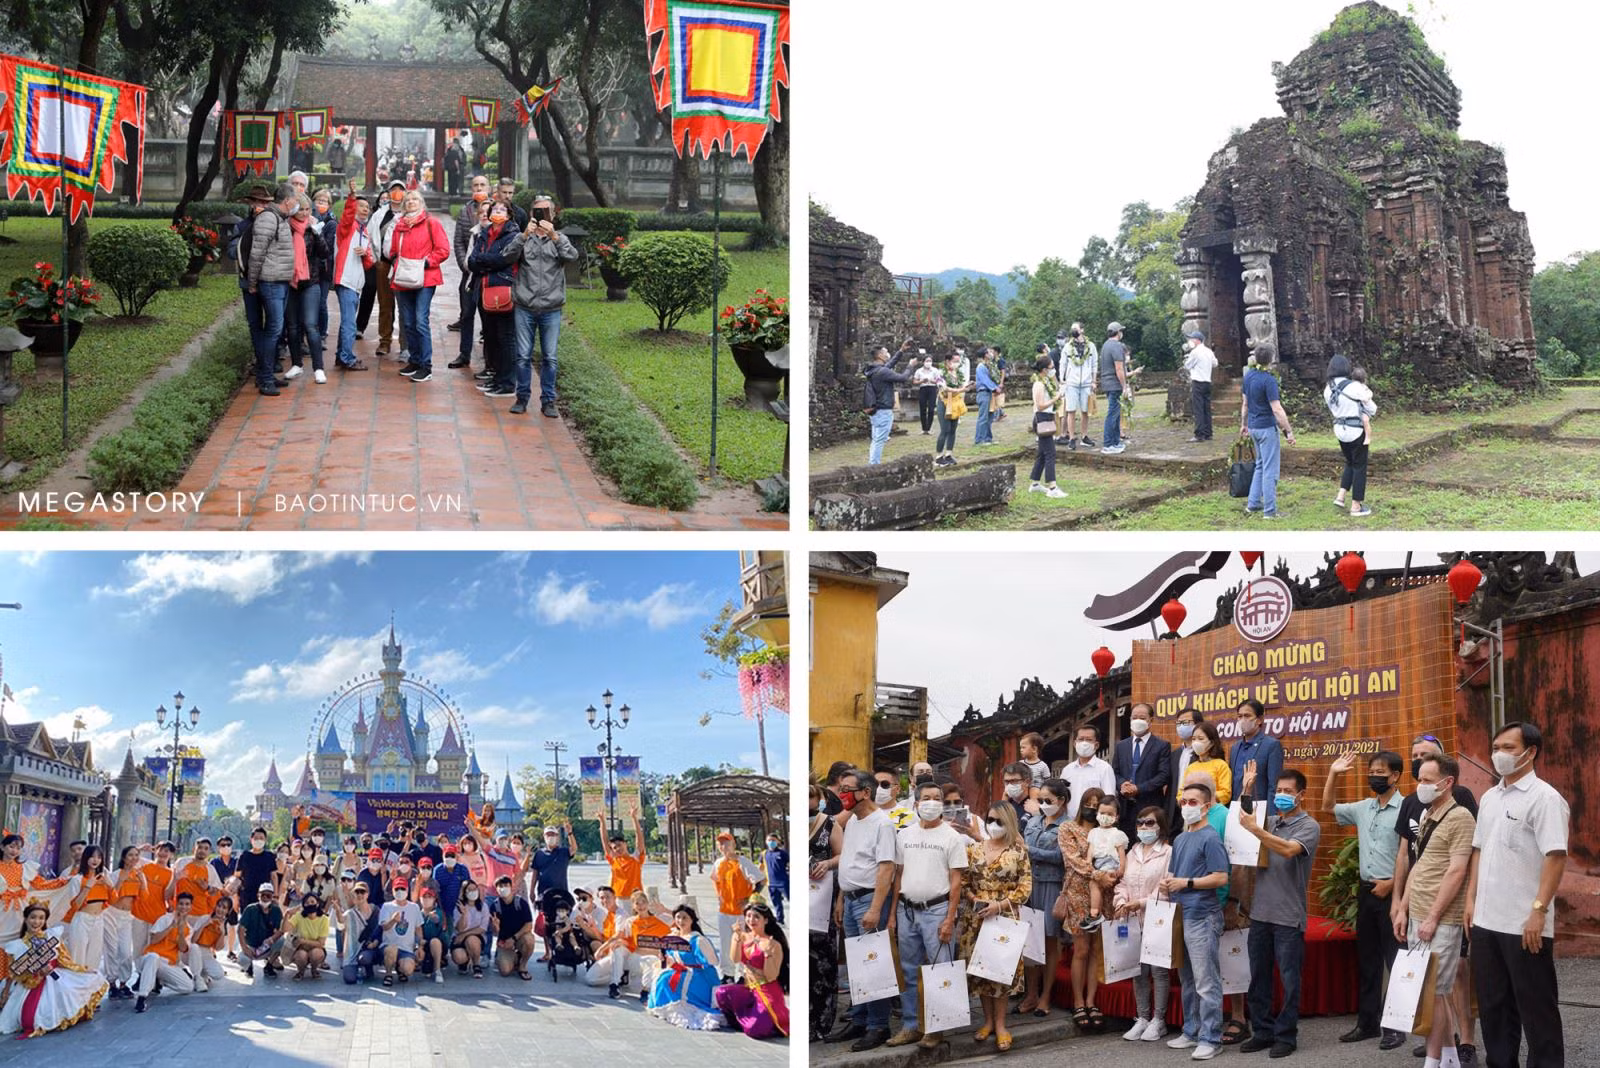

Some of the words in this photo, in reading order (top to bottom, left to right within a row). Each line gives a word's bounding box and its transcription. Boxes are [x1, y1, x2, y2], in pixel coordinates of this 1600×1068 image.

[1213, 649, 1259, 676] CHÀO
[1265, 640, 1326, 670] MỪNG
[1156, 692, 1188, 718] QUÝ
[1193, 688, 1249, 713] KHÁCH
[1255, 680, 1280, 705] VỀ
[1285, 677, 1317, 702] VỚI
[1325, 671, 1359, 701] HỘI
[1367, 669, 1396, 694] AN
[1263, 717, 1285, 735] TO
[1289, 710, 1319, 735] HỘI
[1322, 711, 1348, 730] AN
[1293, 743, 1320, 760] ngày
[1322, 741, 1381, 756] 20/11/2021
